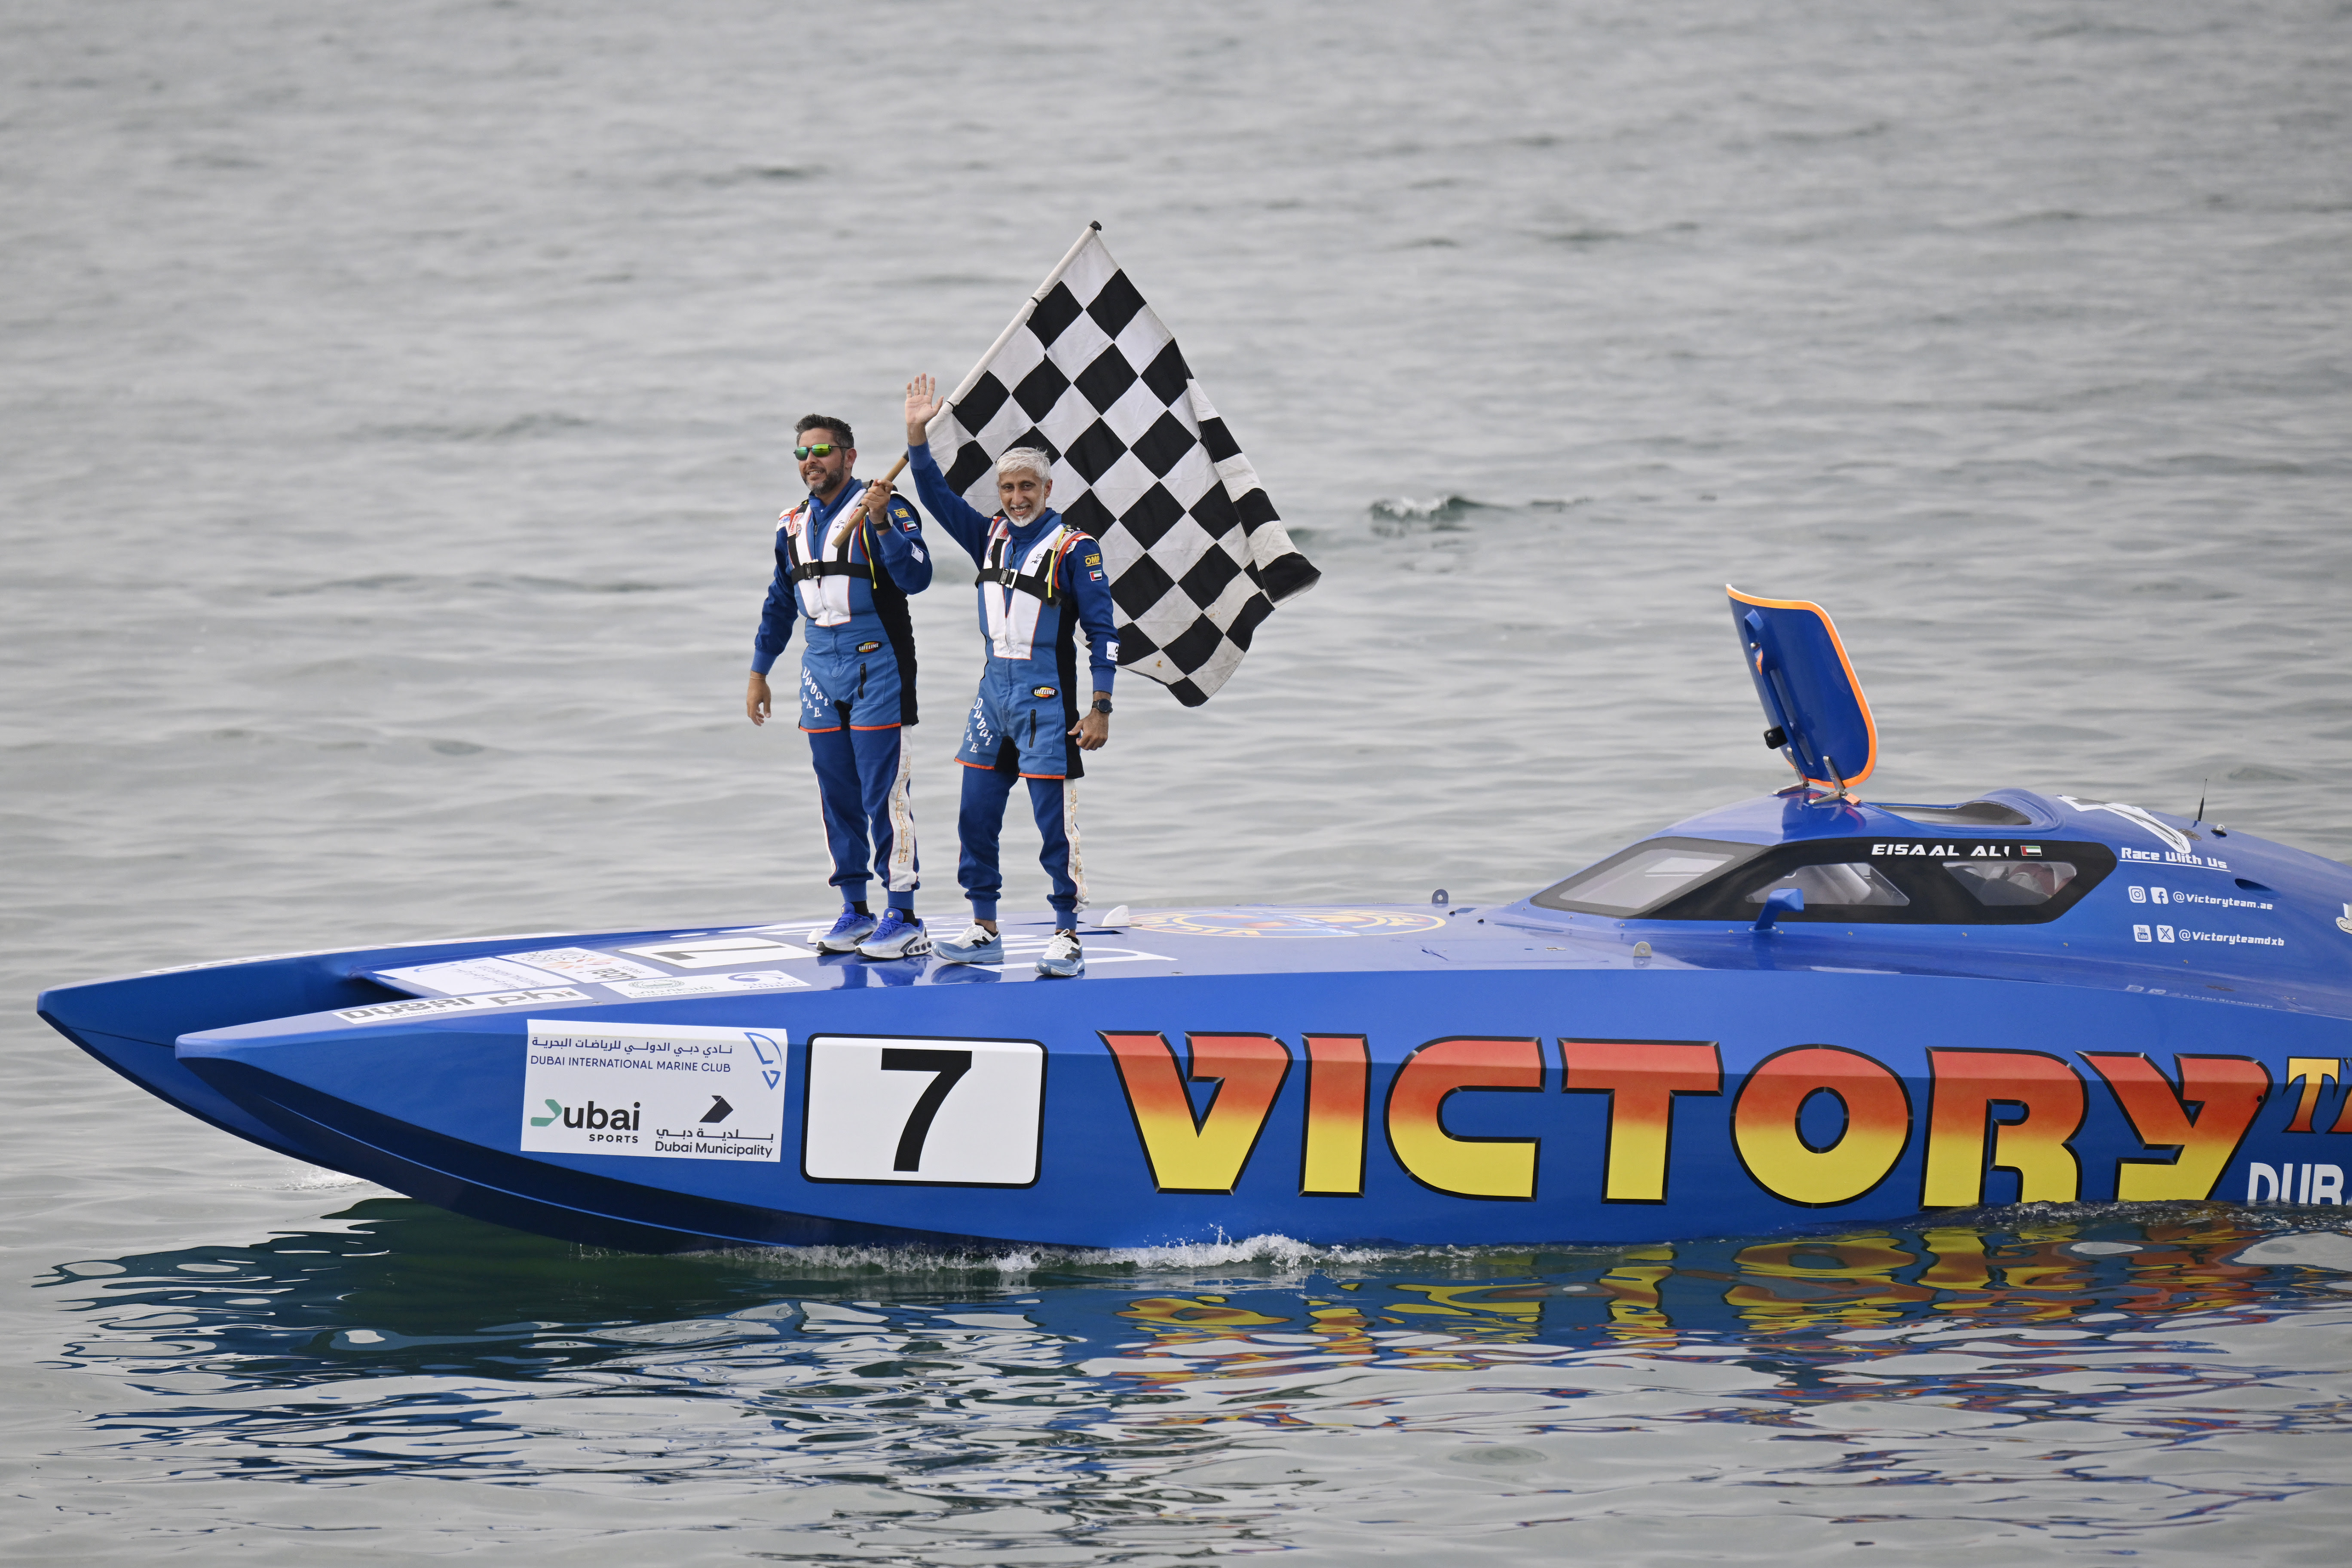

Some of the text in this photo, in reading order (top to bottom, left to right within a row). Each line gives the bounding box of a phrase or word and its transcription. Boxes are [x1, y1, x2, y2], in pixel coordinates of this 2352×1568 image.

[1085, 555, 1100, 565] OMP
[858, 643, 879, 651] LIFELINE
[802, 666, 829, 706] Dubai
[973, 698, 993, 746] Dubai
[1970, 845, 2009, 857] ALI
[2121, 847, 2227, 868] Race With Us
[2173, 891, 2273, 910] @Victoryteam.ae
[2179, 929, 2284, 946] @Victoryteamdxb
[576, 968, 639, 982] ubai
[532, 1037, 732, 1058] نادي دبي الدولي للرياضات البحرية
[530, 1056, 731, 1072] DUBAI INTERNATIONAL MARINE CLUB
[880, 1048, 972, 1172] 7
[1096, 1029, 2274, 1210] VICTORY
[589, 1134, 639, 1144] SPORTS
[656, 1128, 774, 1143] بلدية دبي
[655, 1140, 773, 1158] Dubai Municipality
[2247, 1161, 2352, 1205] DUB
